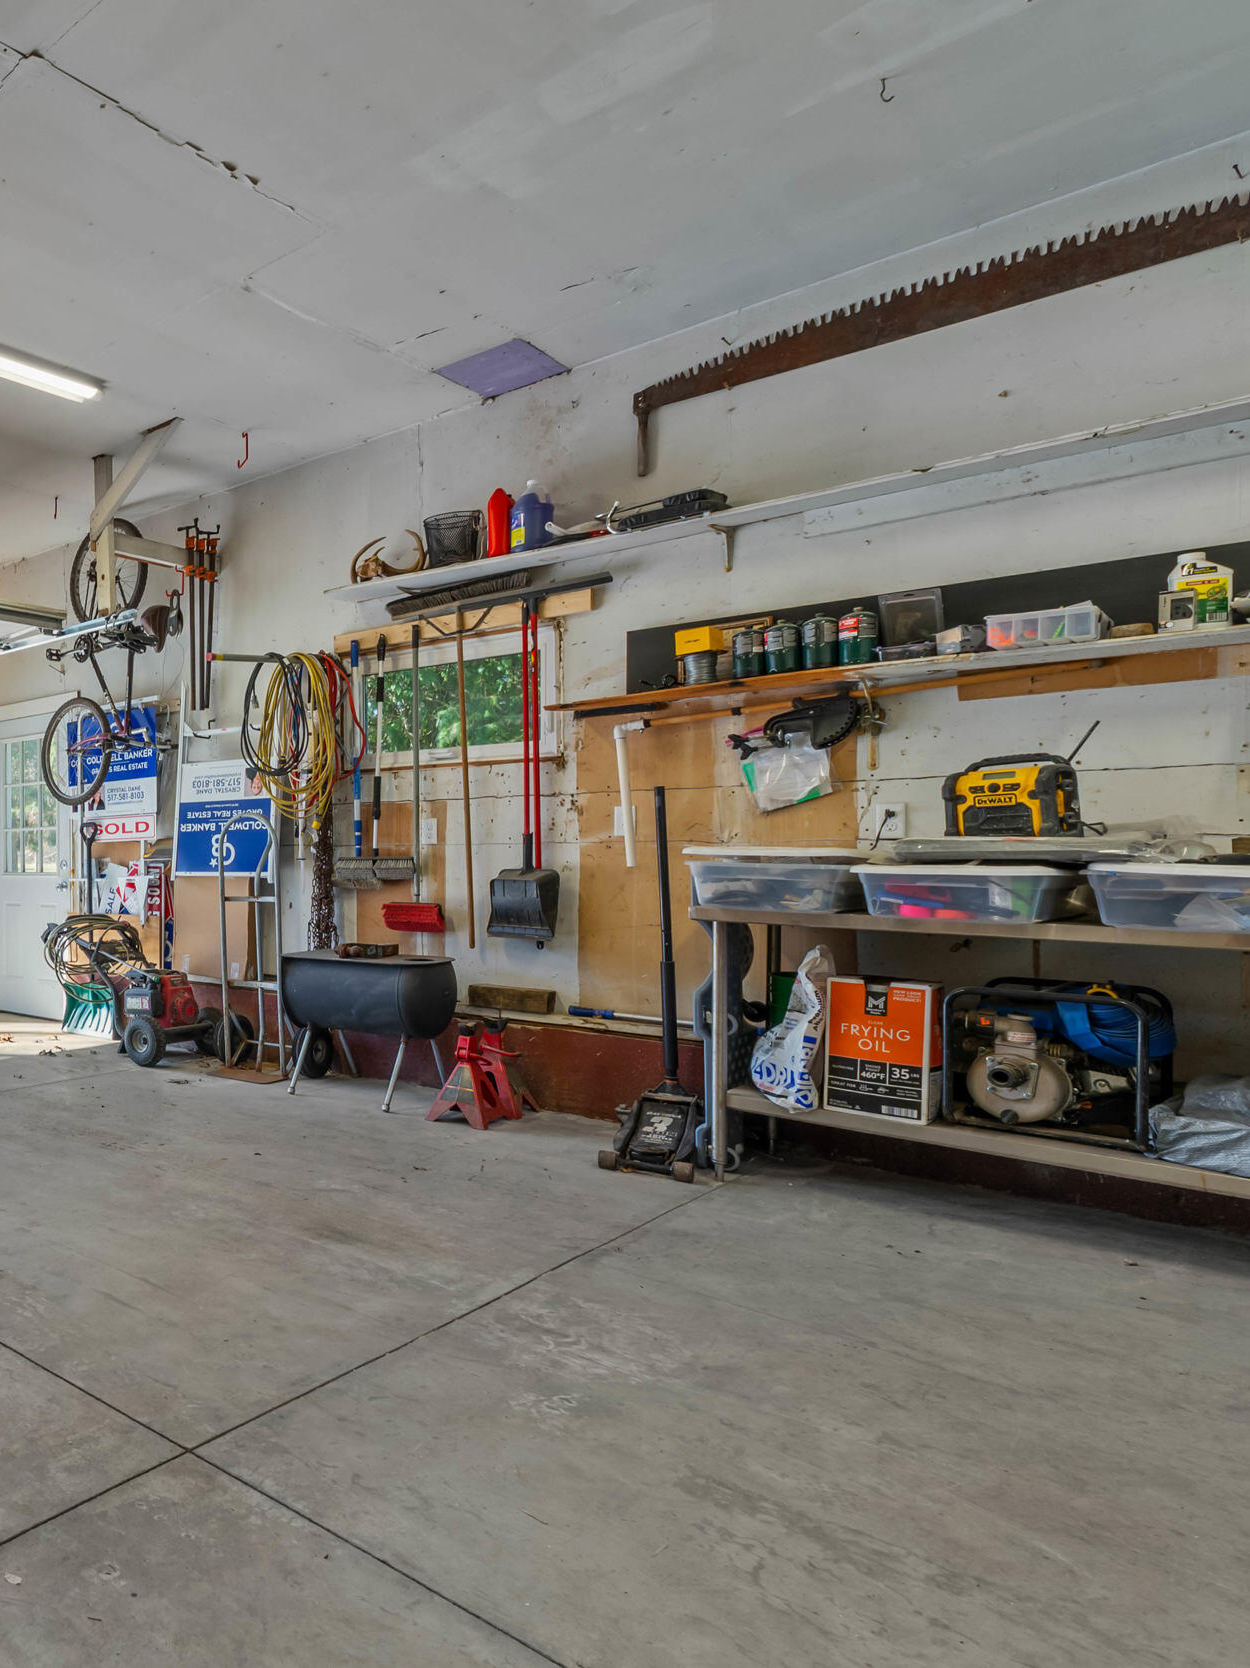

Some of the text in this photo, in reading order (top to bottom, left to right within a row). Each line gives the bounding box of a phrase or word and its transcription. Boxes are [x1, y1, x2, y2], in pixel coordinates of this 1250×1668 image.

[124, 748, 153, 760] BANKER
[128, 762, 148, 770] ESTATE
[192, 777, 241, 788] 517-581-8103
[215, 786, 241, 794] CRYSTAL
[107, 792, 145, 802] 517-581-8103
[186, 811, 212, 819] ESTATE
[213, 809, 231, 818] REAL
[180, 823, 216, 832] BANKER
[840, 1023, 911, 1042] FRYING
[858, 1038, 891, 1053] OIL
[860, 1071, 886, 1080] 460°F
[891, 1067, 910, 1079] 35
